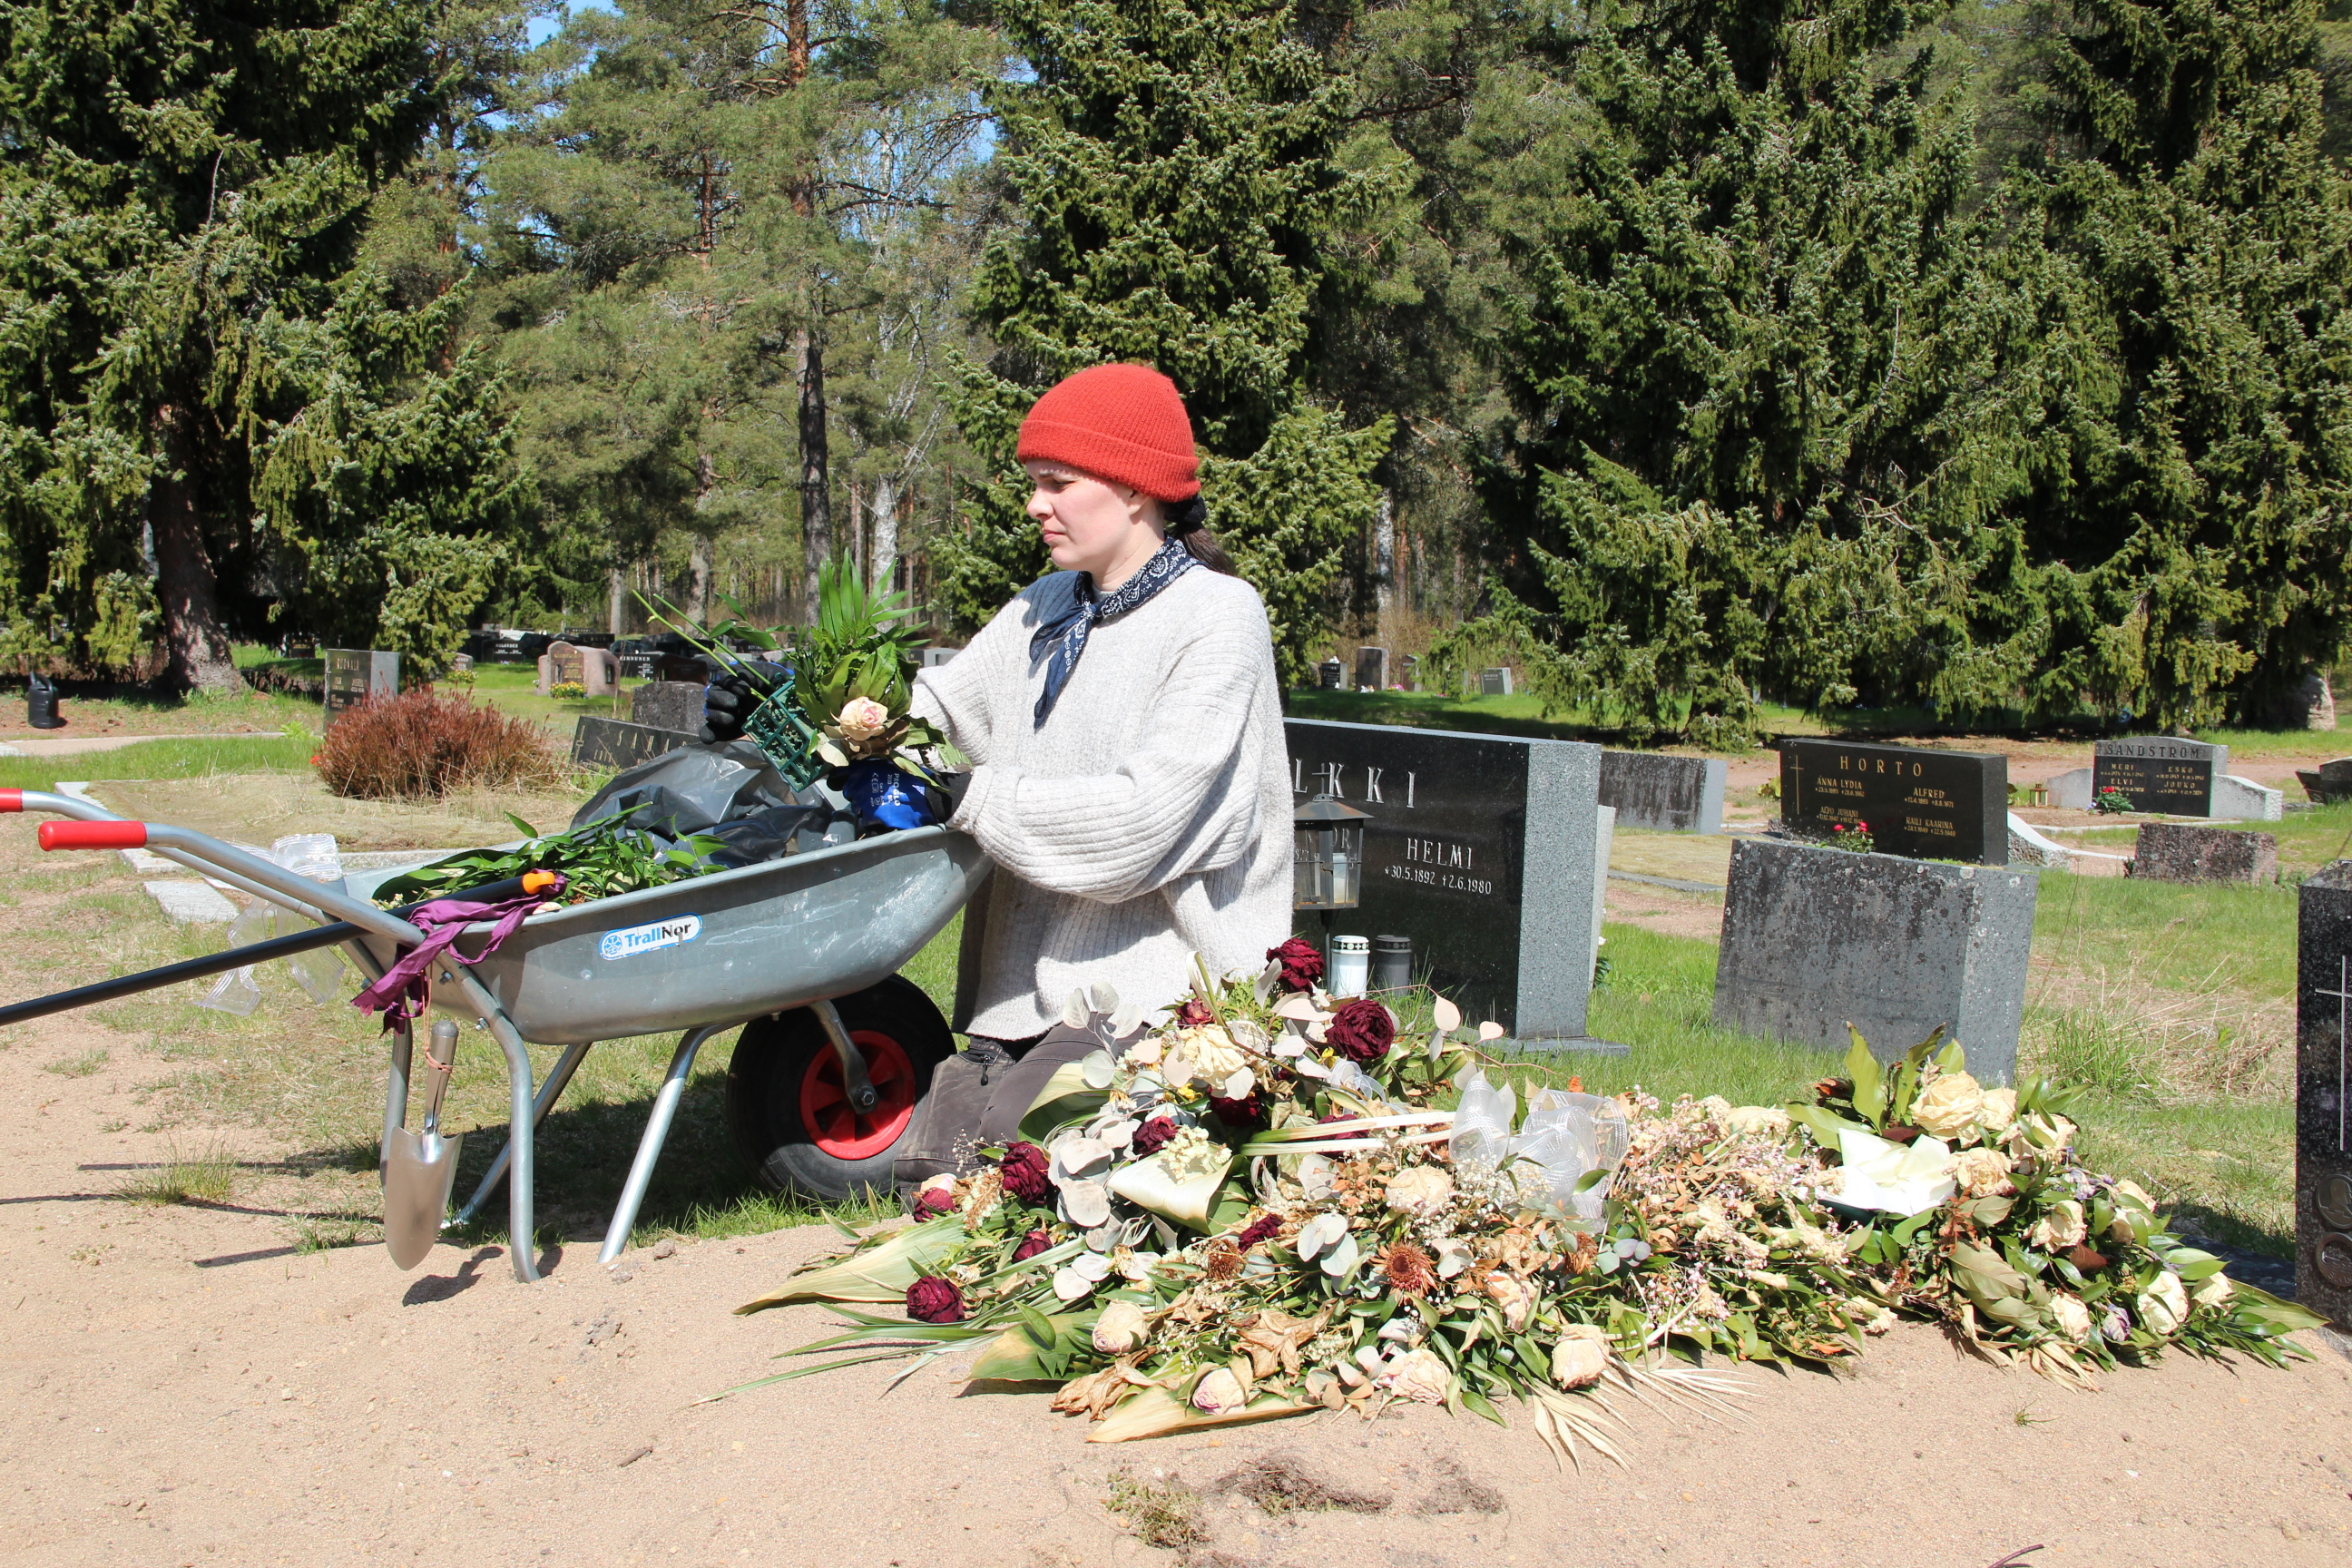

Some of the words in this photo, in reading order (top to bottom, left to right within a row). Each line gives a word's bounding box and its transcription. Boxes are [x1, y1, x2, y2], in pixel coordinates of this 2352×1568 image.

[2107, 744, 2200, 759] SANDSTRÖM
[1840, 756, 1922, 777] HORTO
[893, 773, 901, 806] PROGLO
[1817, 778, 1838, 787] ANNA
[1840, 779, 1862, 789] LYDIA
[2164, 781, 2196, 789] JOUKO
[1913, 788, 1945, 799] ALFRED
[1838, 808, 1858, 818] JUHANI
[1906, 817, 1922, 826] RAILI
[1925, 819, 1954, 829] KAARINA
[1406, 838, 1474, 870] HELMI
[624, 923, 691, 946] TrallNor
